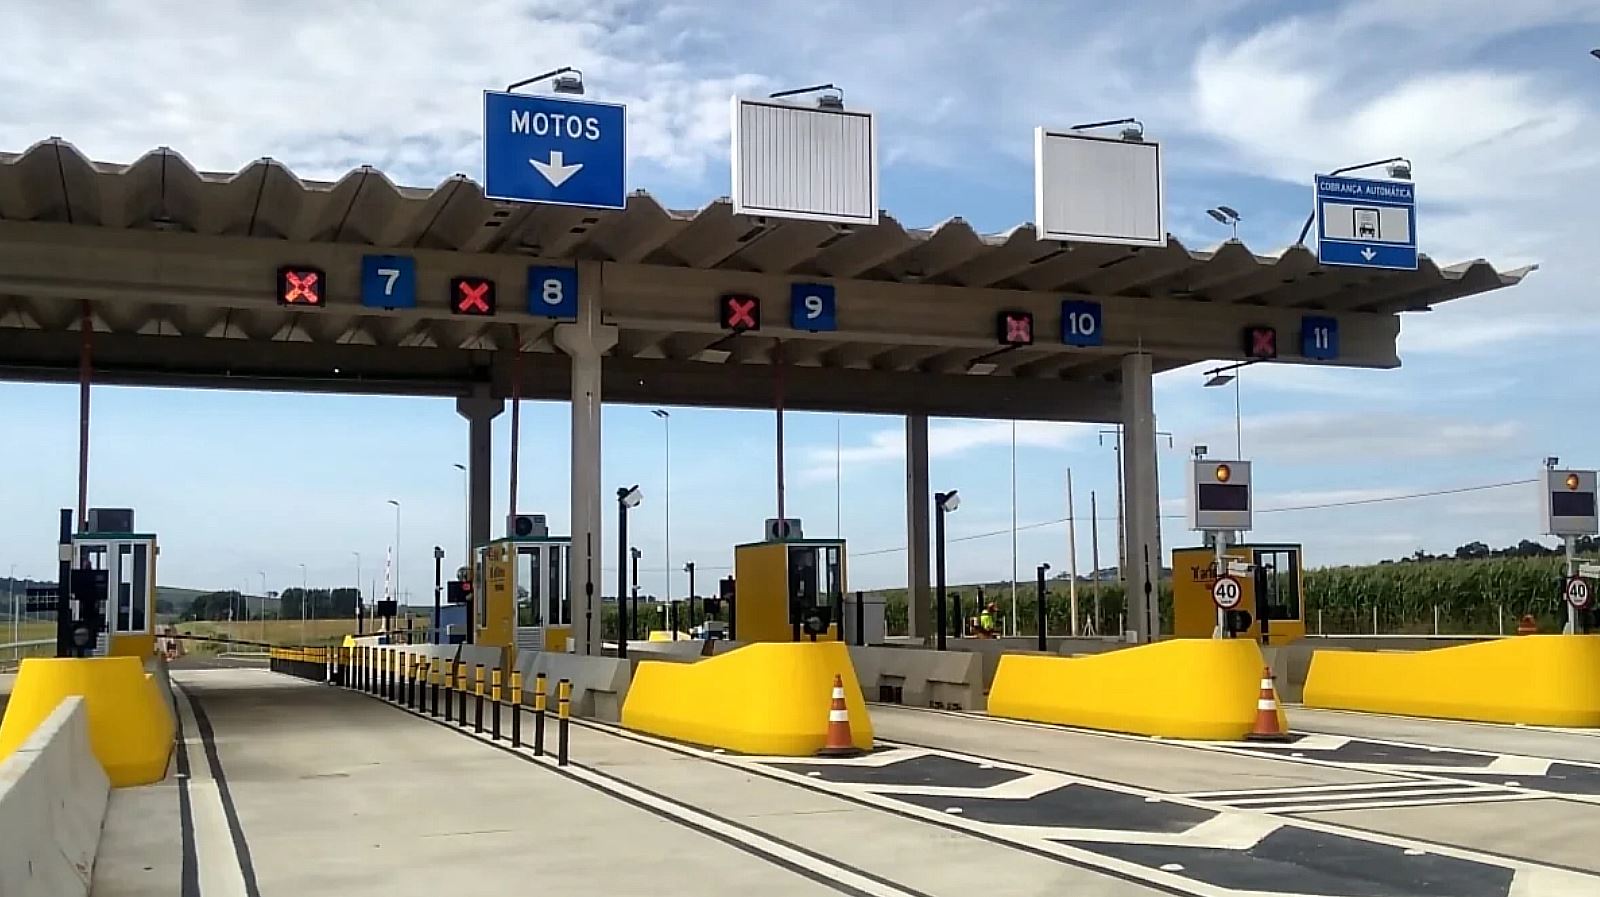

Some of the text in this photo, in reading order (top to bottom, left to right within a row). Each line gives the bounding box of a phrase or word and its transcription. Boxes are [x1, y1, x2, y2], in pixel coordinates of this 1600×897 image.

[510, 109, 600, 140] MOTOS
[1320, 182, 1412, 199] COBRANÇA AUTOMÁTICA
[377, 268, 400, 296] 7
[543, 279, 563, 305] 8
[805, 295, 822, 319] 9
[1069, 311, 1095, 335] 10
[1314, 327, 1329, 349] 11
[1216, 584, 1237, 599] 40
[1569, 583, 1586, 598] 40
